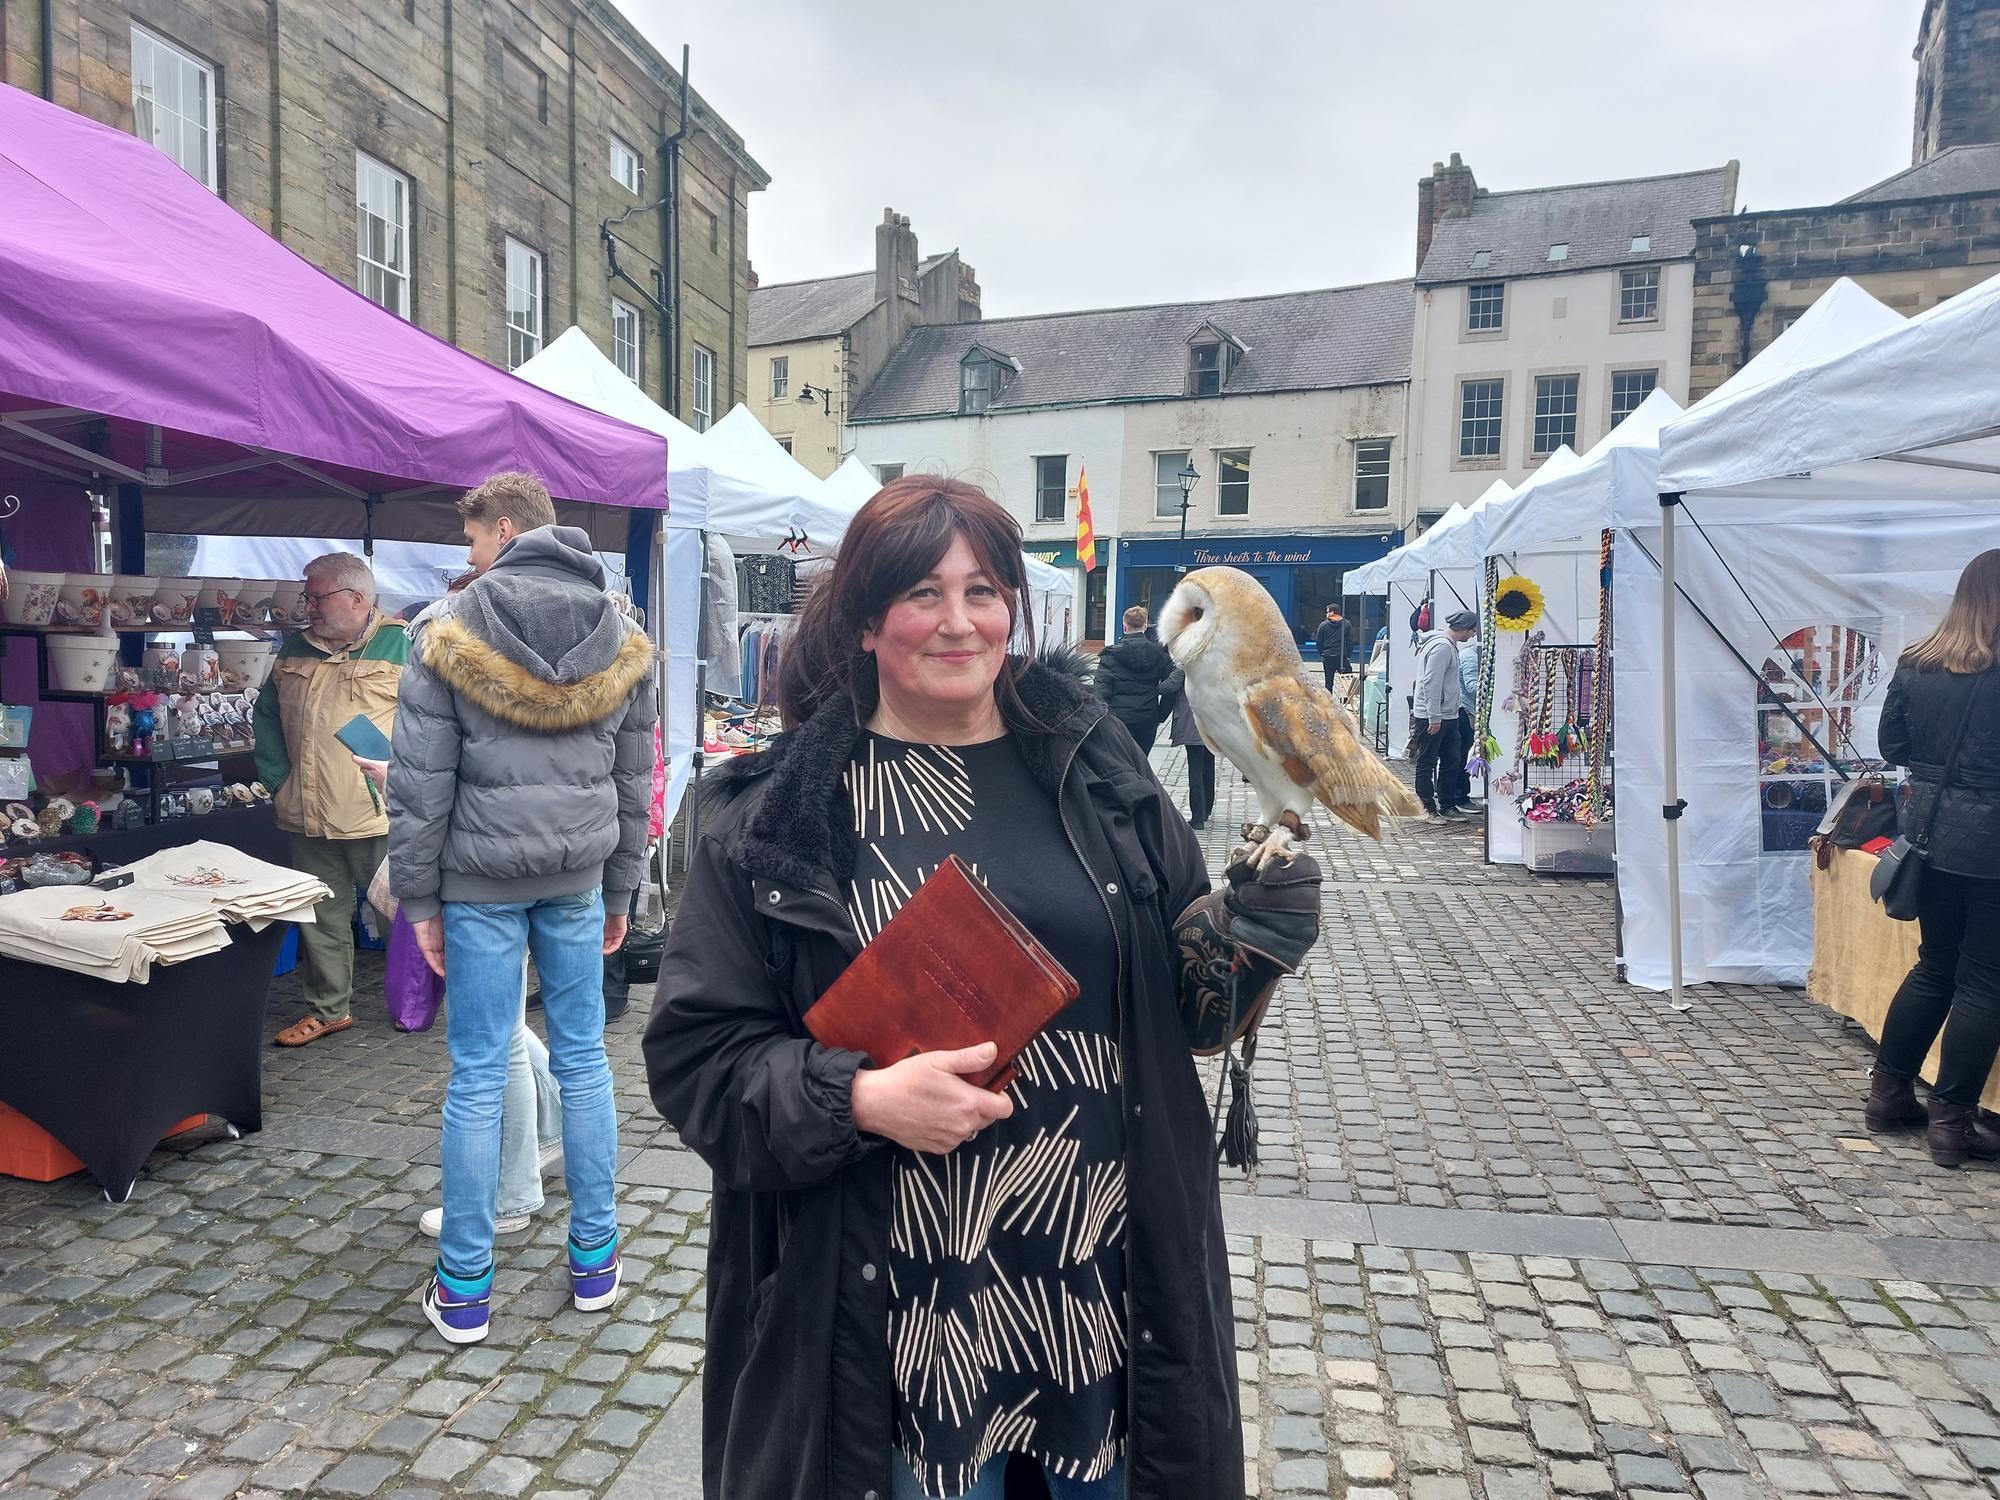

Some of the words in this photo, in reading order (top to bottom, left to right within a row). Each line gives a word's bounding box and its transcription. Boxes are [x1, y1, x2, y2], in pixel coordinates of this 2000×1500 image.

[1194, 549, 1221, 563] Three
[1223, 551, 1250, 563] sheets
[1253, 551, 1262, 562] to
[1266, 550, 1281, 562] the
[1284, 549, 1311, 562] wind
